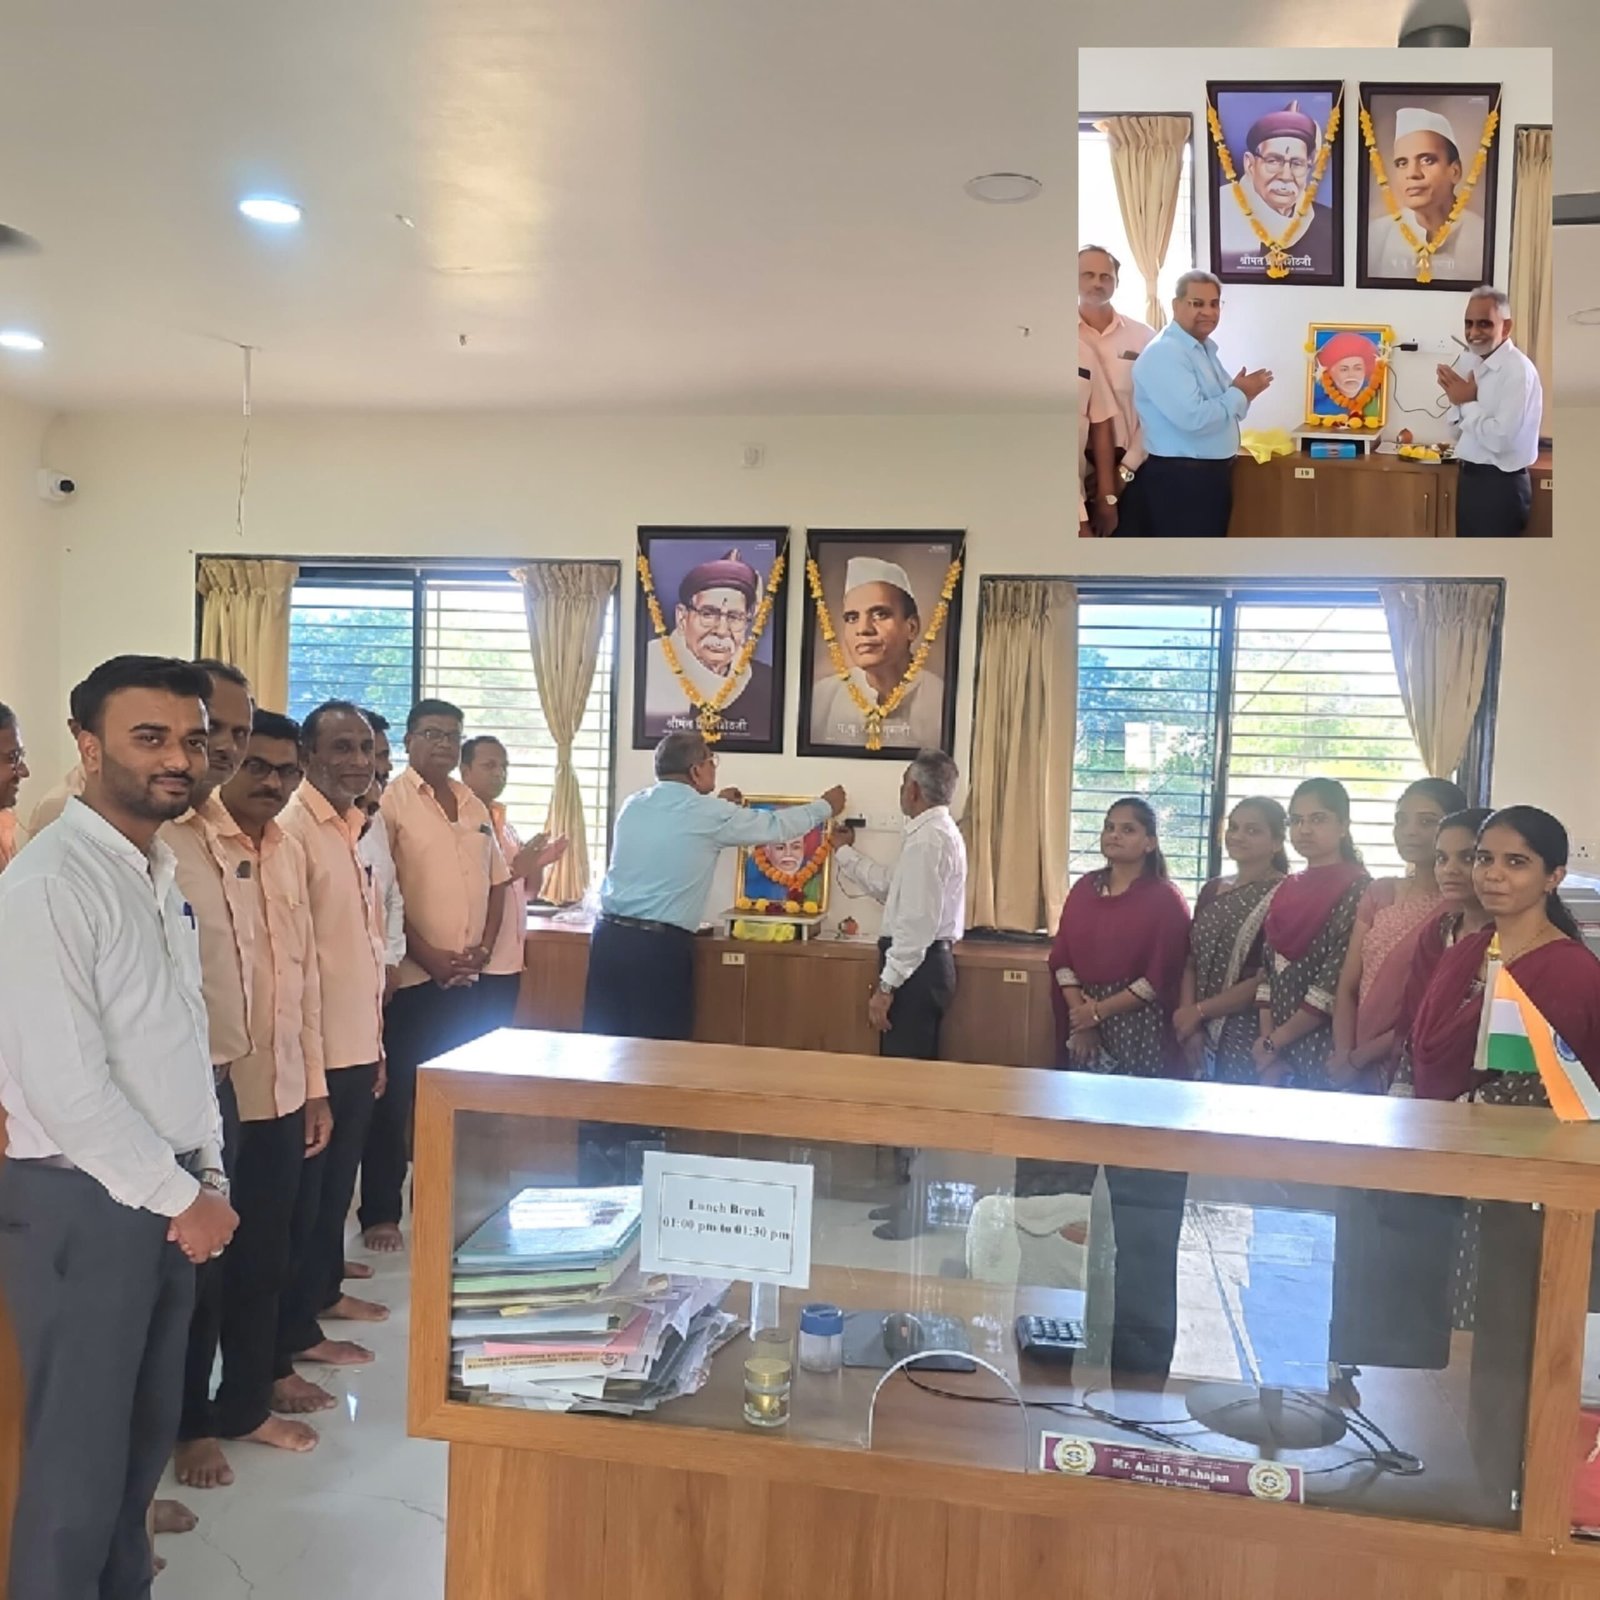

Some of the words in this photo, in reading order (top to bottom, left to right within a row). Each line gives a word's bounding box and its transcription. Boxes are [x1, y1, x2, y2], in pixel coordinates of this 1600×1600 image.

[688, 1198, 727, 1214] Lunch
[729, 1203, 766, 1218] Break
[662, 1216, 695, 1230] 01:00
[697, 1221, 717, 1234] pm
[719, 1223, 732, 1234] to
[733, 1224, 767, 1239] 01:30
[769, 1229, 790, 1241] pm
[1112, 1457, 1132, 1470] Mr.
[1135, 1461, 1160, 1474] Anil
[1177, 1467, 1230, 1484] Mahajan
